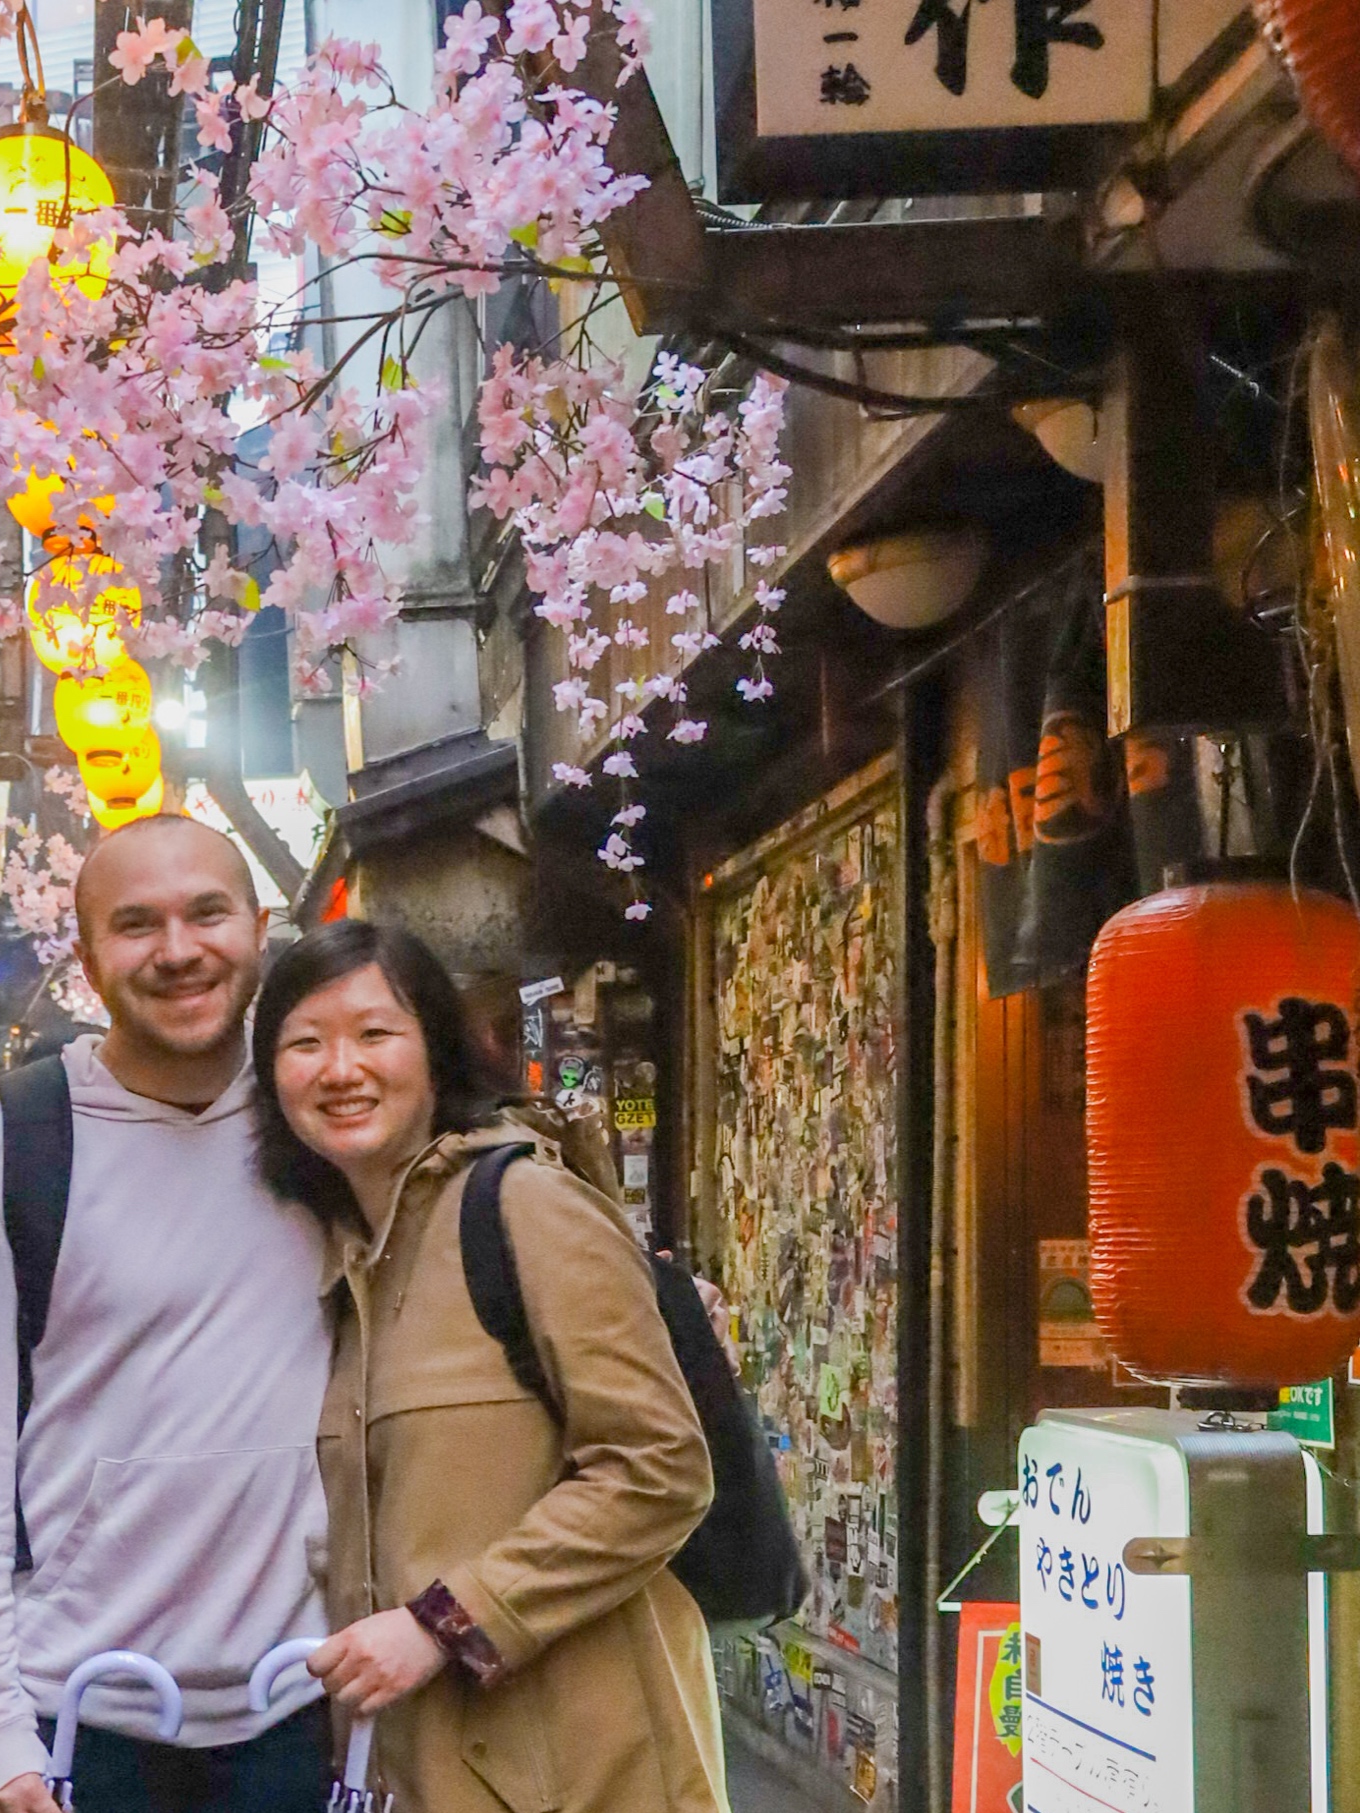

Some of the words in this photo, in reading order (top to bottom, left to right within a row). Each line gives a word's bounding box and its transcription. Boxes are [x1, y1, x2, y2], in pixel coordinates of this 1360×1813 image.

[813, 0, 872, 107] 一輪
[1022, 1453, 1091, 1525] おでん
[1036, 1536, 1126, 1622] やきとり
[1100, 1640, 1156, 1718] 焼き
